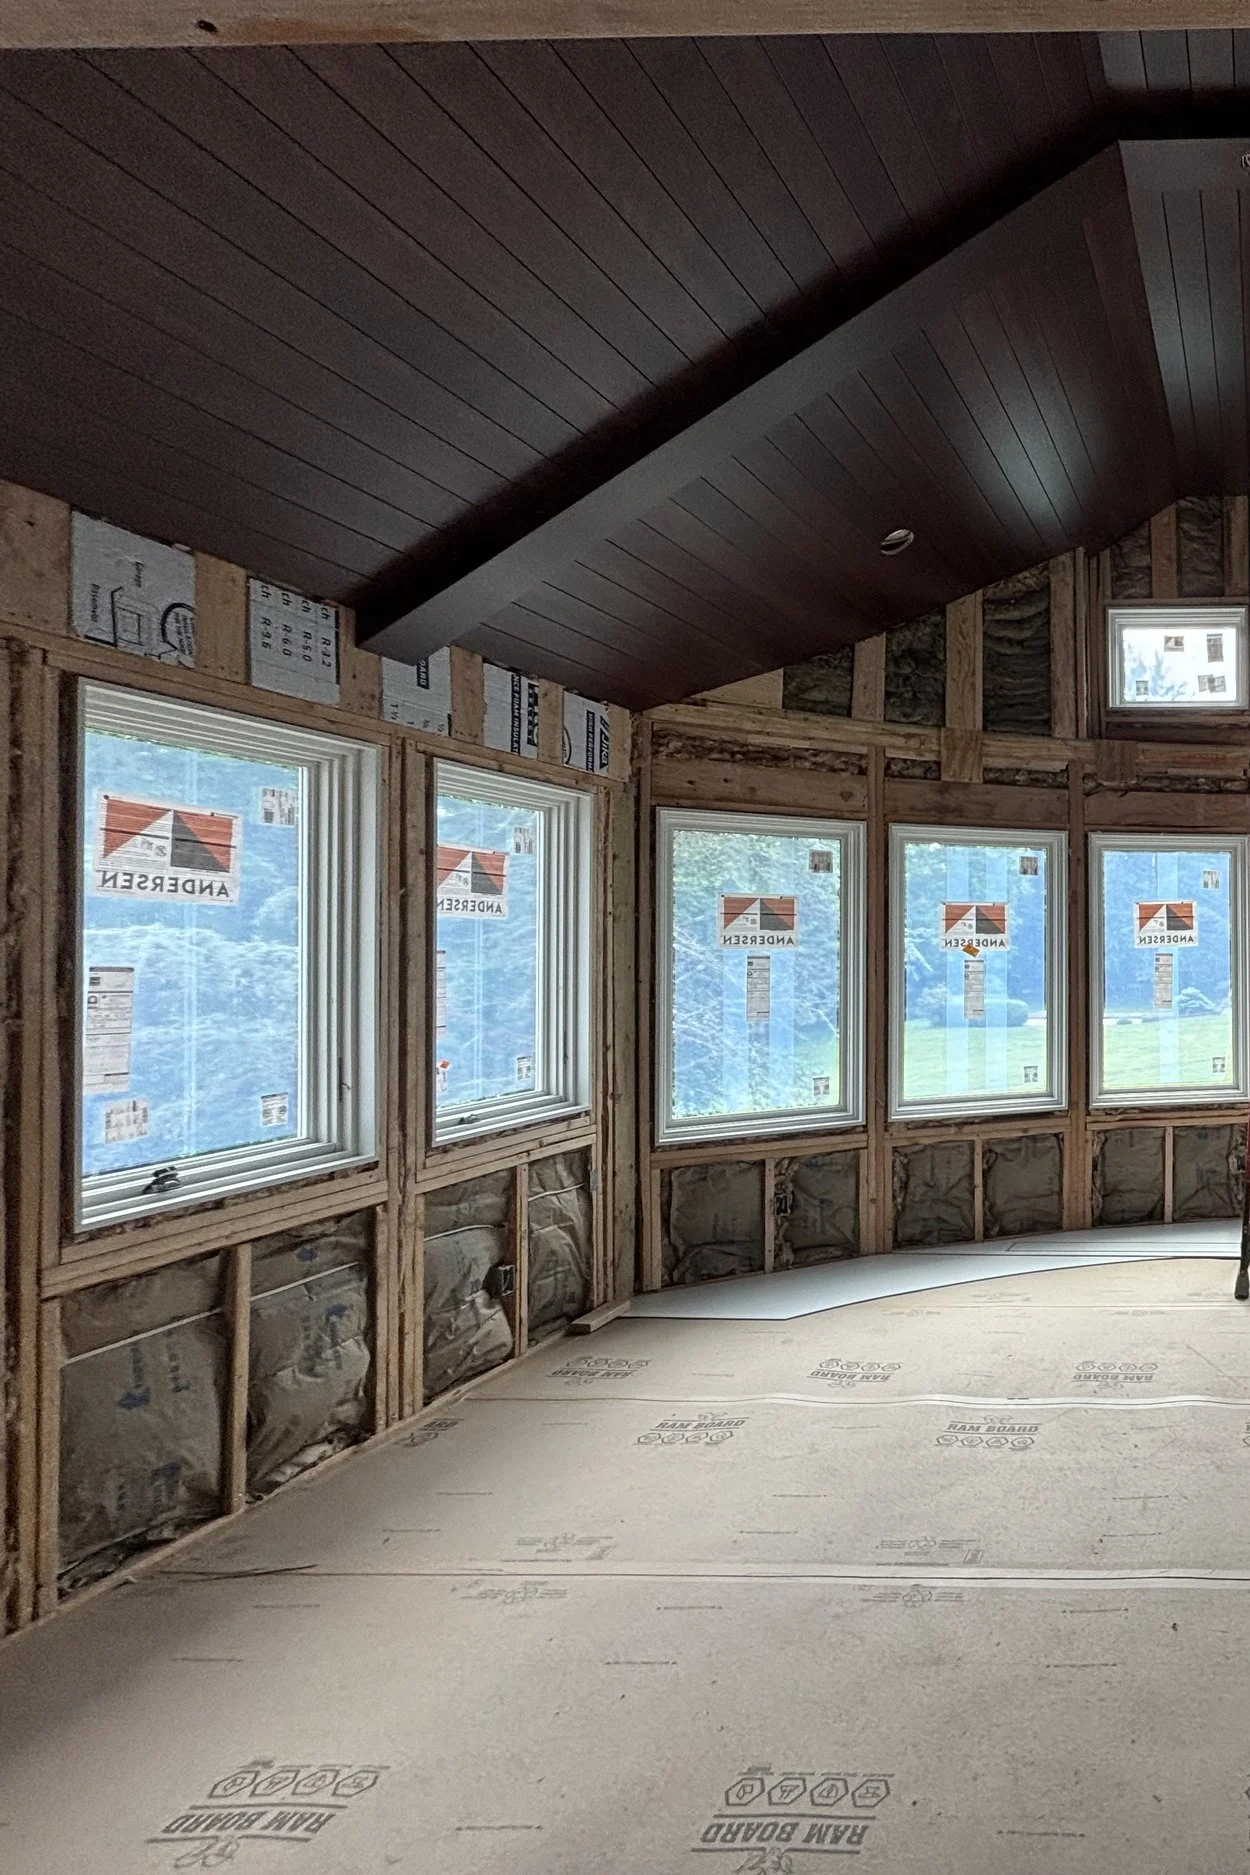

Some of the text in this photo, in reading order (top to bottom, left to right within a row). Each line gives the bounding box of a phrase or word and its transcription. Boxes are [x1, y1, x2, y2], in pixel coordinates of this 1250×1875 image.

[261, 616, 272, 650] R-9.6
[282, 623, 292, 656] R-6.0
[302, 630, 312, 662] R-5.0
[321, 637, 332, 668] R-3.2
[512, 692, 520, 717] FOAM
[512, 717, 520, 753] INSULAT
[600, 1370, 633, 1378] RAM
[810, 1371, 891, 1381] RAM BOARD
[693, 1419, 746, 1429] BOARD
[946, 1423, 1040, 1433] RAM BOARD
[161, 1811, 336, 1834] RAM BOARD
[700, 1821, 870, 1845] RAM BOARD
